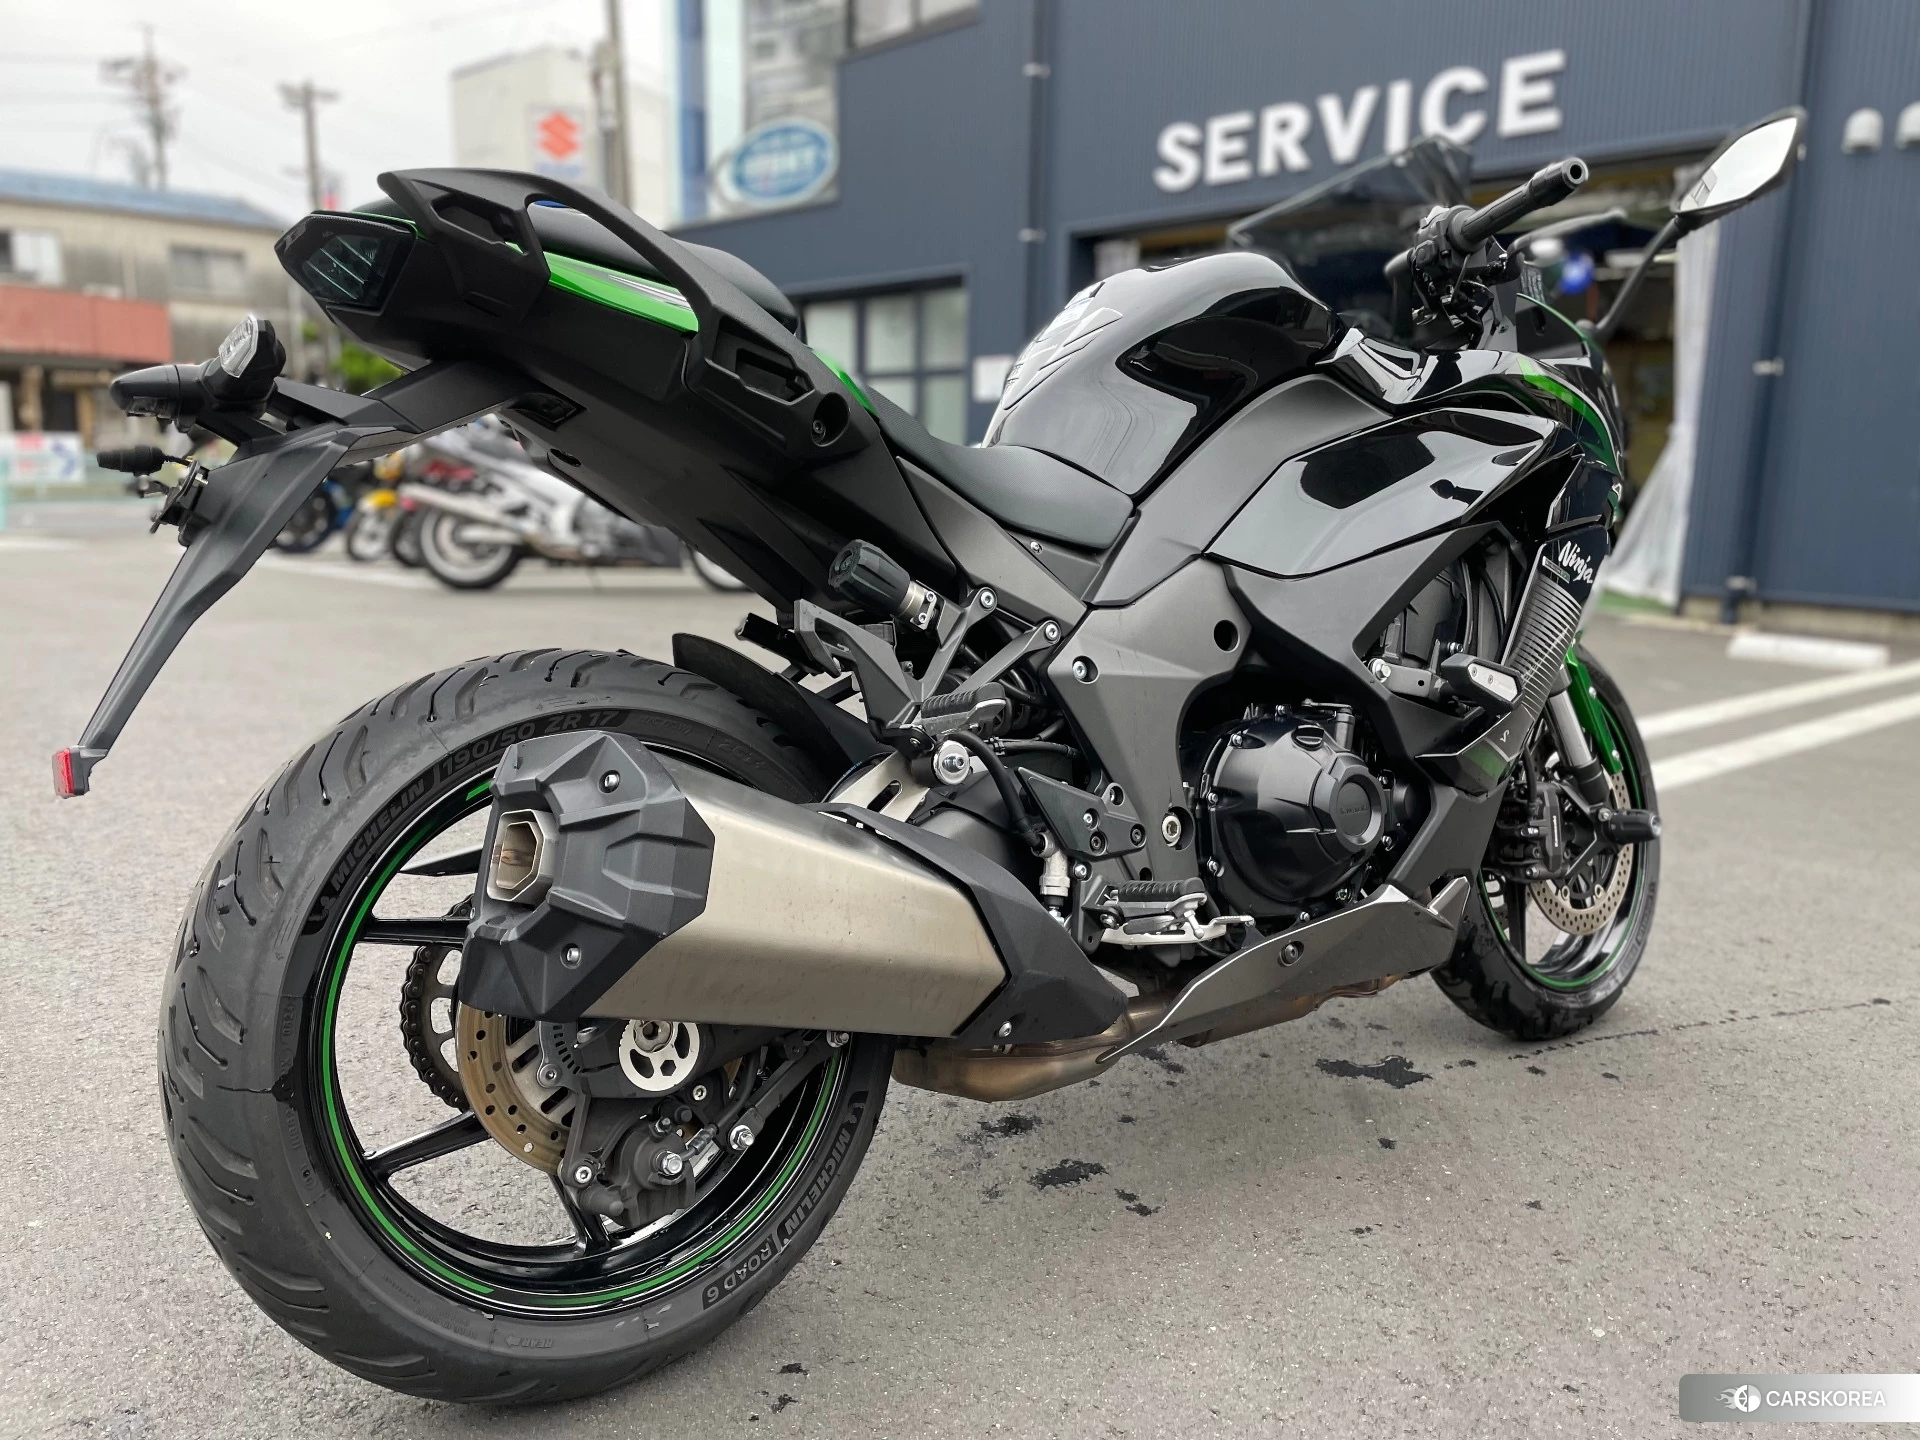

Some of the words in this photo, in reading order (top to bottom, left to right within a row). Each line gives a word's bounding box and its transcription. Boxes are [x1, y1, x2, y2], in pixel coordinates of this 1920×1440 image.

[1153, 48, 1567, 193] SERVICE
[1557, 540, 1594, 584] Ninja
[330, 777, 426, 891] MICHELIN
[442, 721, 537, 775] 190/50
[543, 710, 582, 735] ZR
[590, 709, 621, 728] 17
[784, 1127, 851, 1236] MICHELIN
[723, 1235, 774, 1292] ROAD
[706, 1285, 720, 1302] 6
[521, 1337, 555, 1349] REAR
